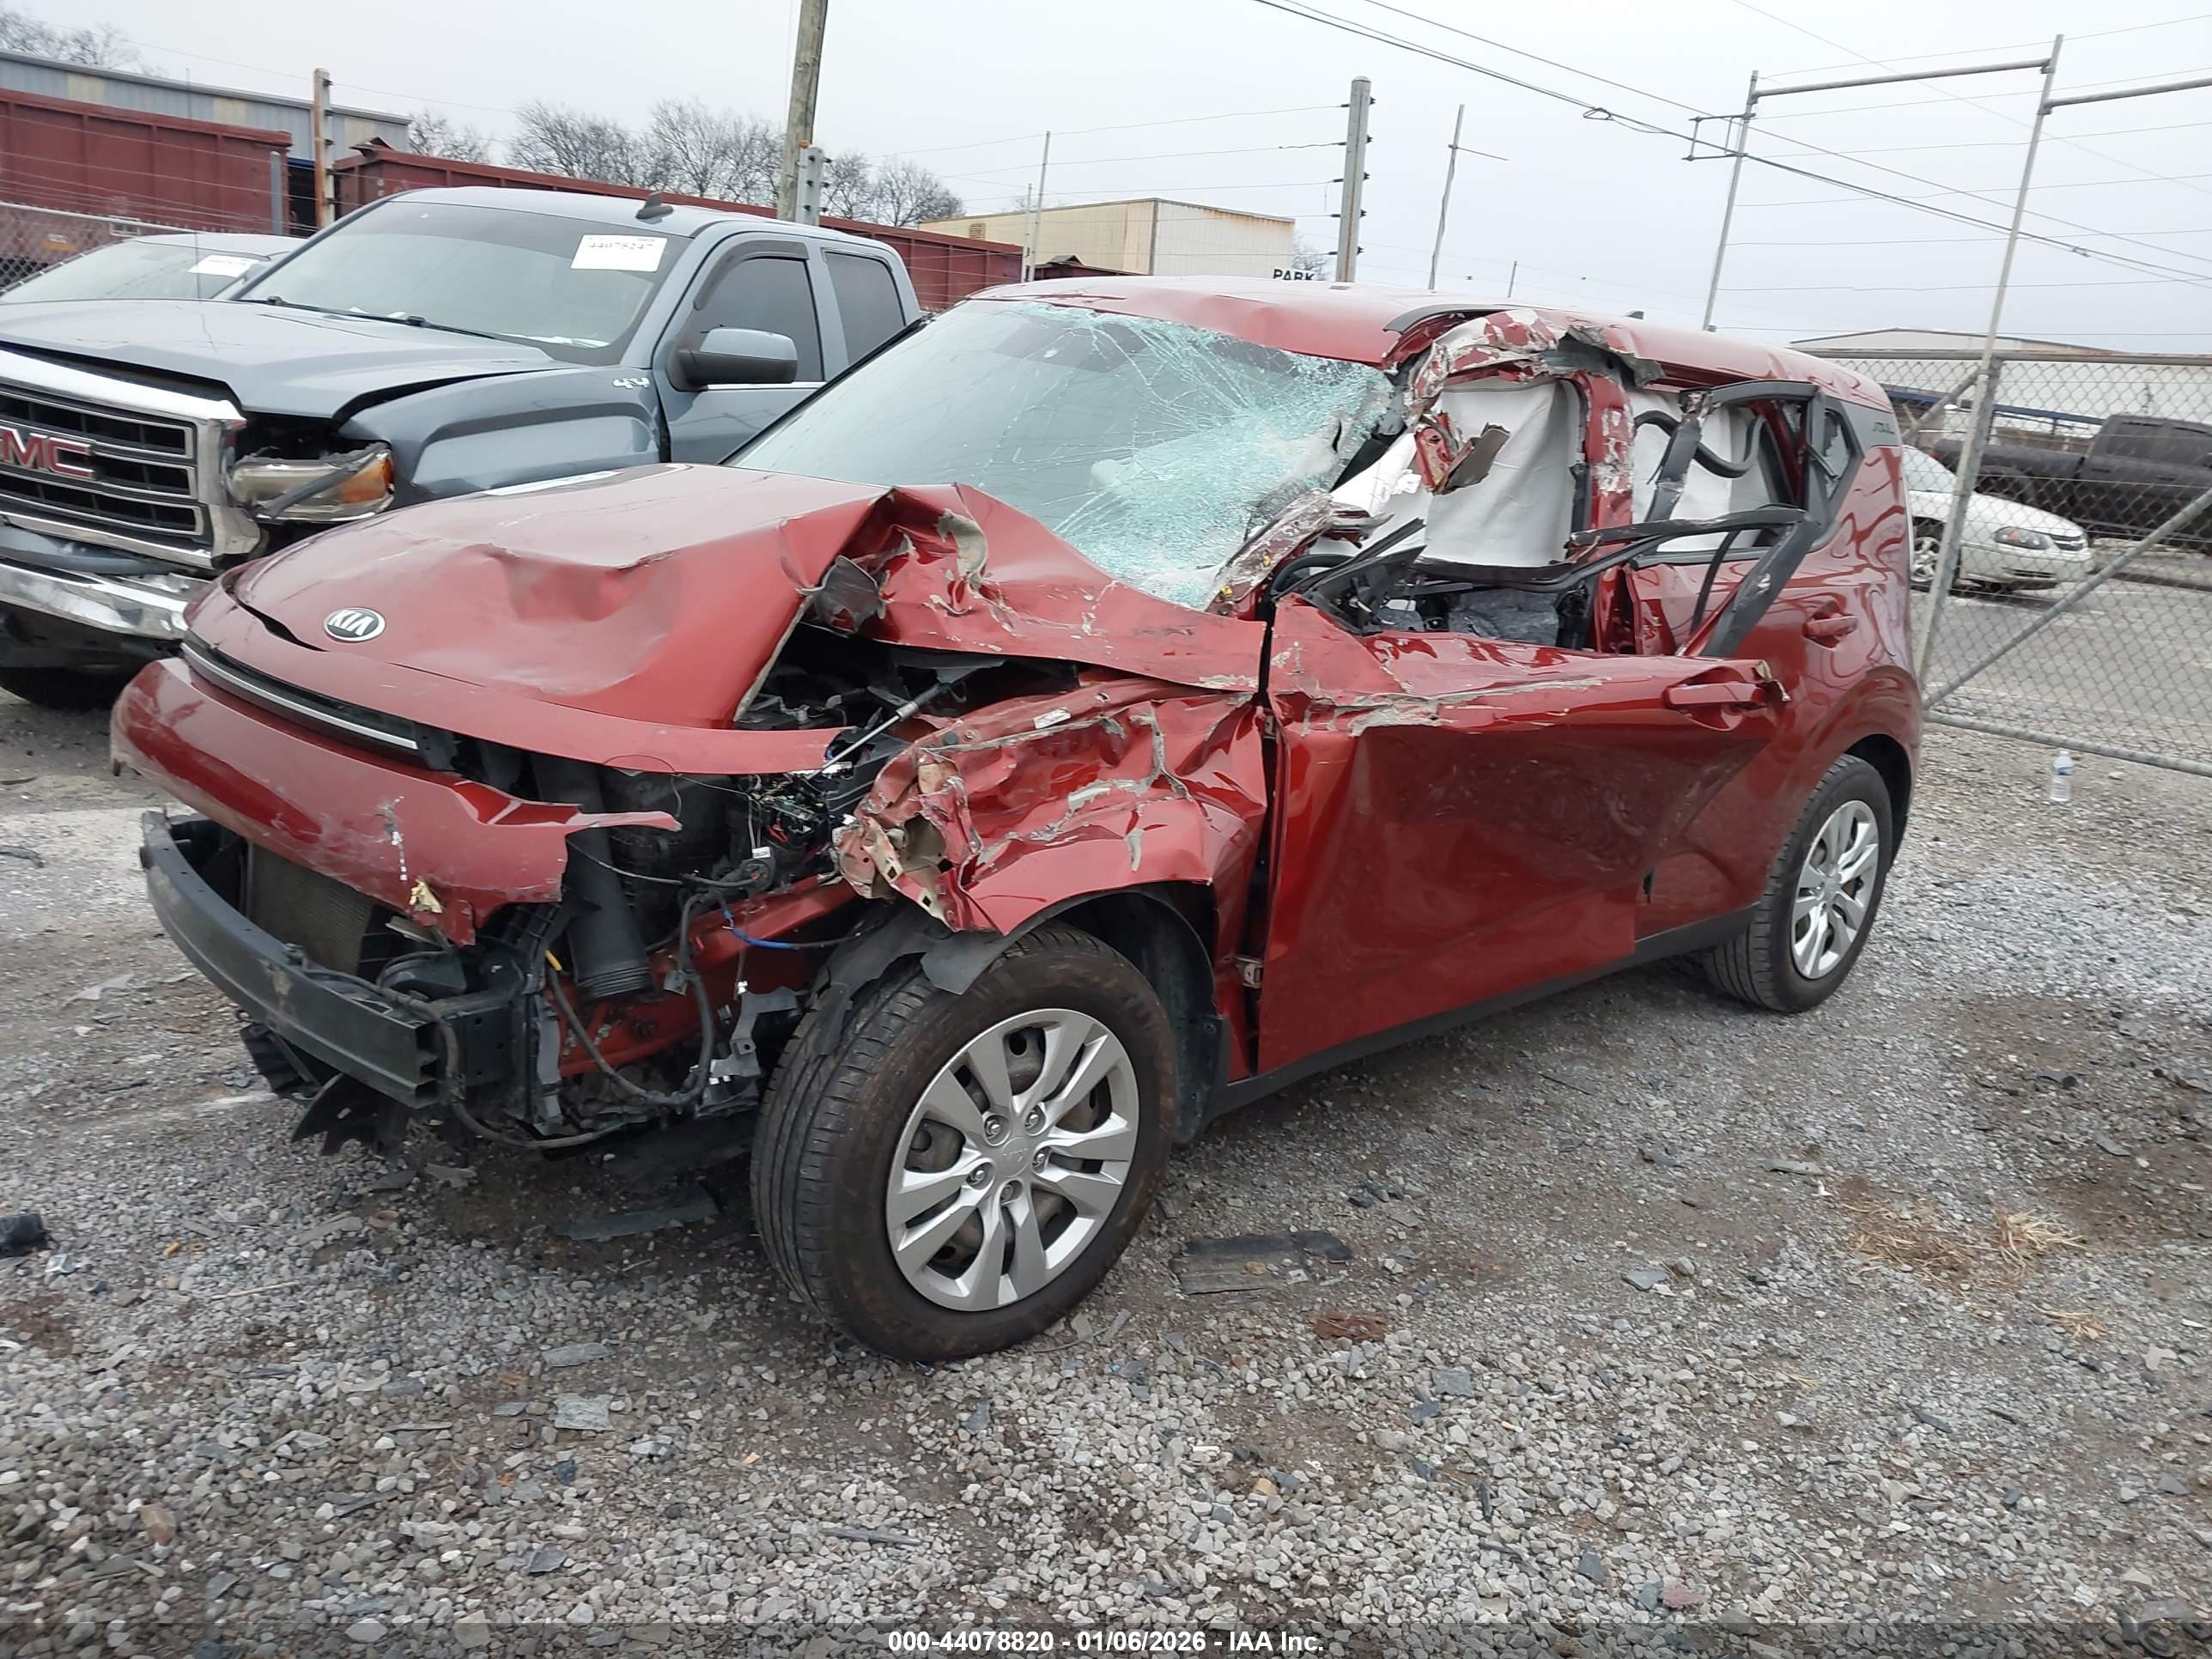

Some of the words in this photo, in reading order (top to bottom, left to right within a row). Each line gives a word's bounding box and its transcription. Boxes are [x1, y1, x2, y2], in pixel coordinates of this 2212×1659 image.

[1273, 269, 1316, 280] PARK
[0, 426, 95, 479] MC
[327, 609, 374, 636] KIA
